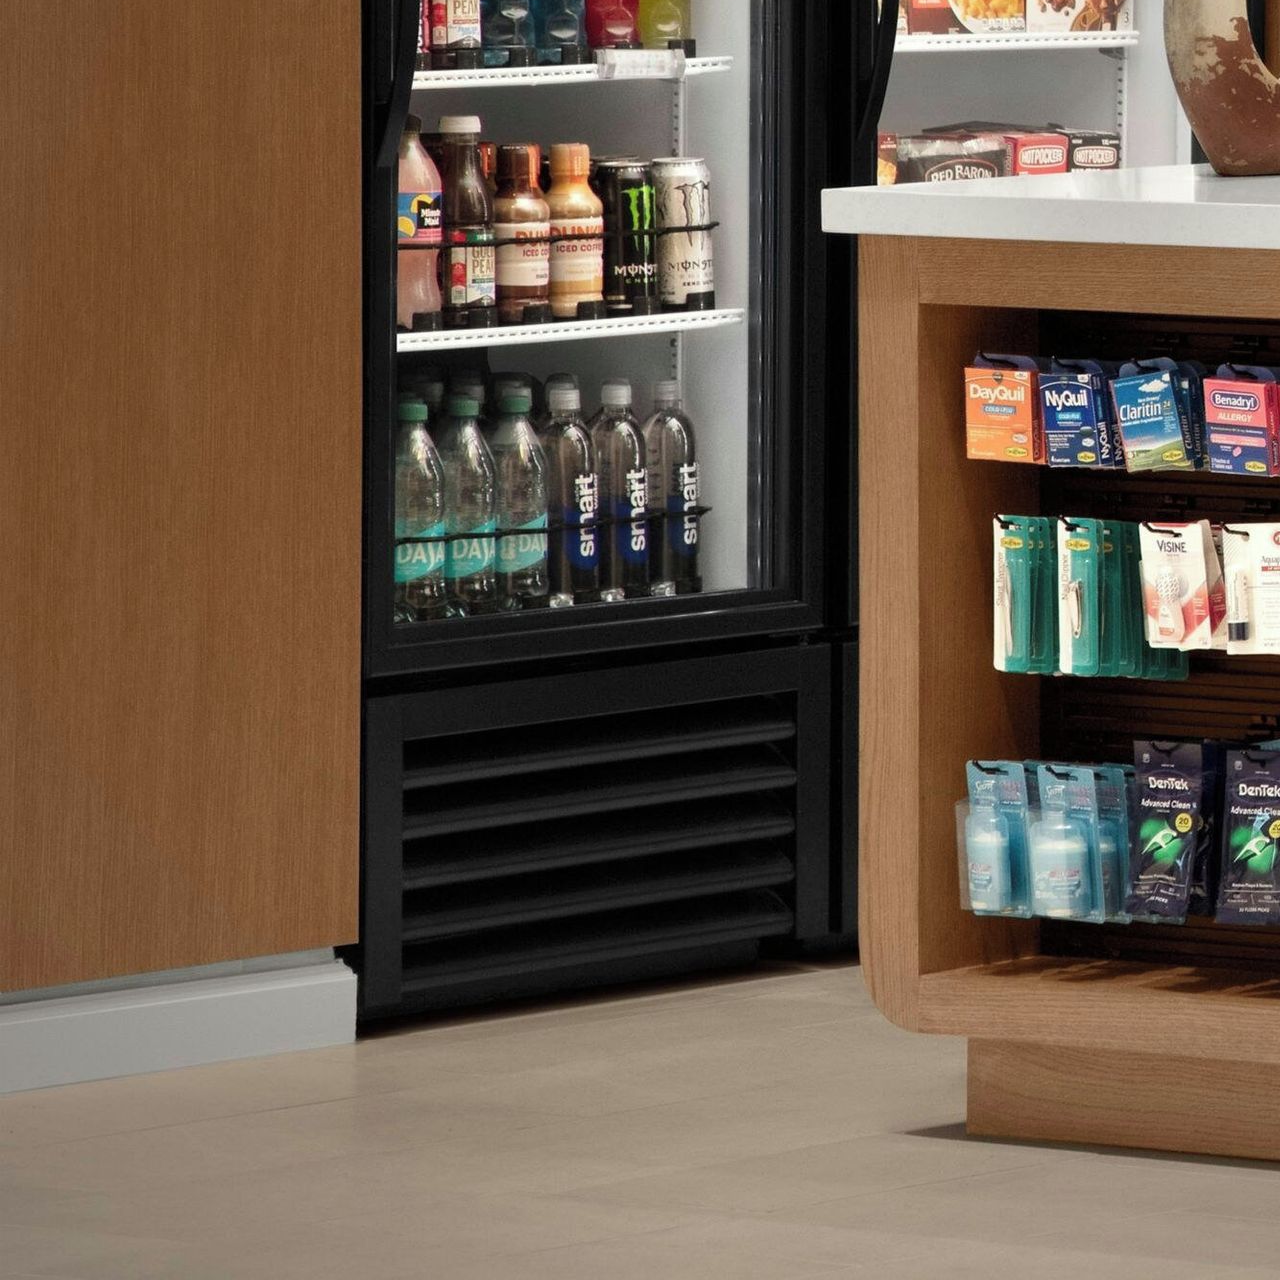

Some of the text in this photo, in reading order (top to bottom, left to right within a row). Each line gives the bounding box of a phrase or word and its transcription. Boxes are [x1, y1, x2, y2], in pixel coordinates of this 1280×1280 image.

[1124, 12, 1129, 23] 3
[932, 165, 993, 182] RED BARON
[556, 244, 577, 253] ICED
[614, 262, 657, 277] MONST
[668, 259, 712, 272] MONST
[969, 383, 1025, 403] DayQuil
[1045, 389, 1088, 411] NyQuil
[1214, 394, 1255, 408] Benadryl
[1120, 402, 1161, 421] Claritin
[1217, 412, 1253, 422] ALLERGY
[1181, 415, 1192, 449] Claritin
[1098, 422, 1111, 459] NyQuil
[626, 468, 646, 551] smart
[679, 463, 698, 545] smart
[574, 473, 595, 557] smart
[1157, 540, 1187, 553] VISINE
[1148, 777, 1189, 791] DenTek
[1141, 798, 1191, 809] Advanced Clean
[1230, 806, 1262, 816] Advanced
[1178, 817, 1189, 825] 20
